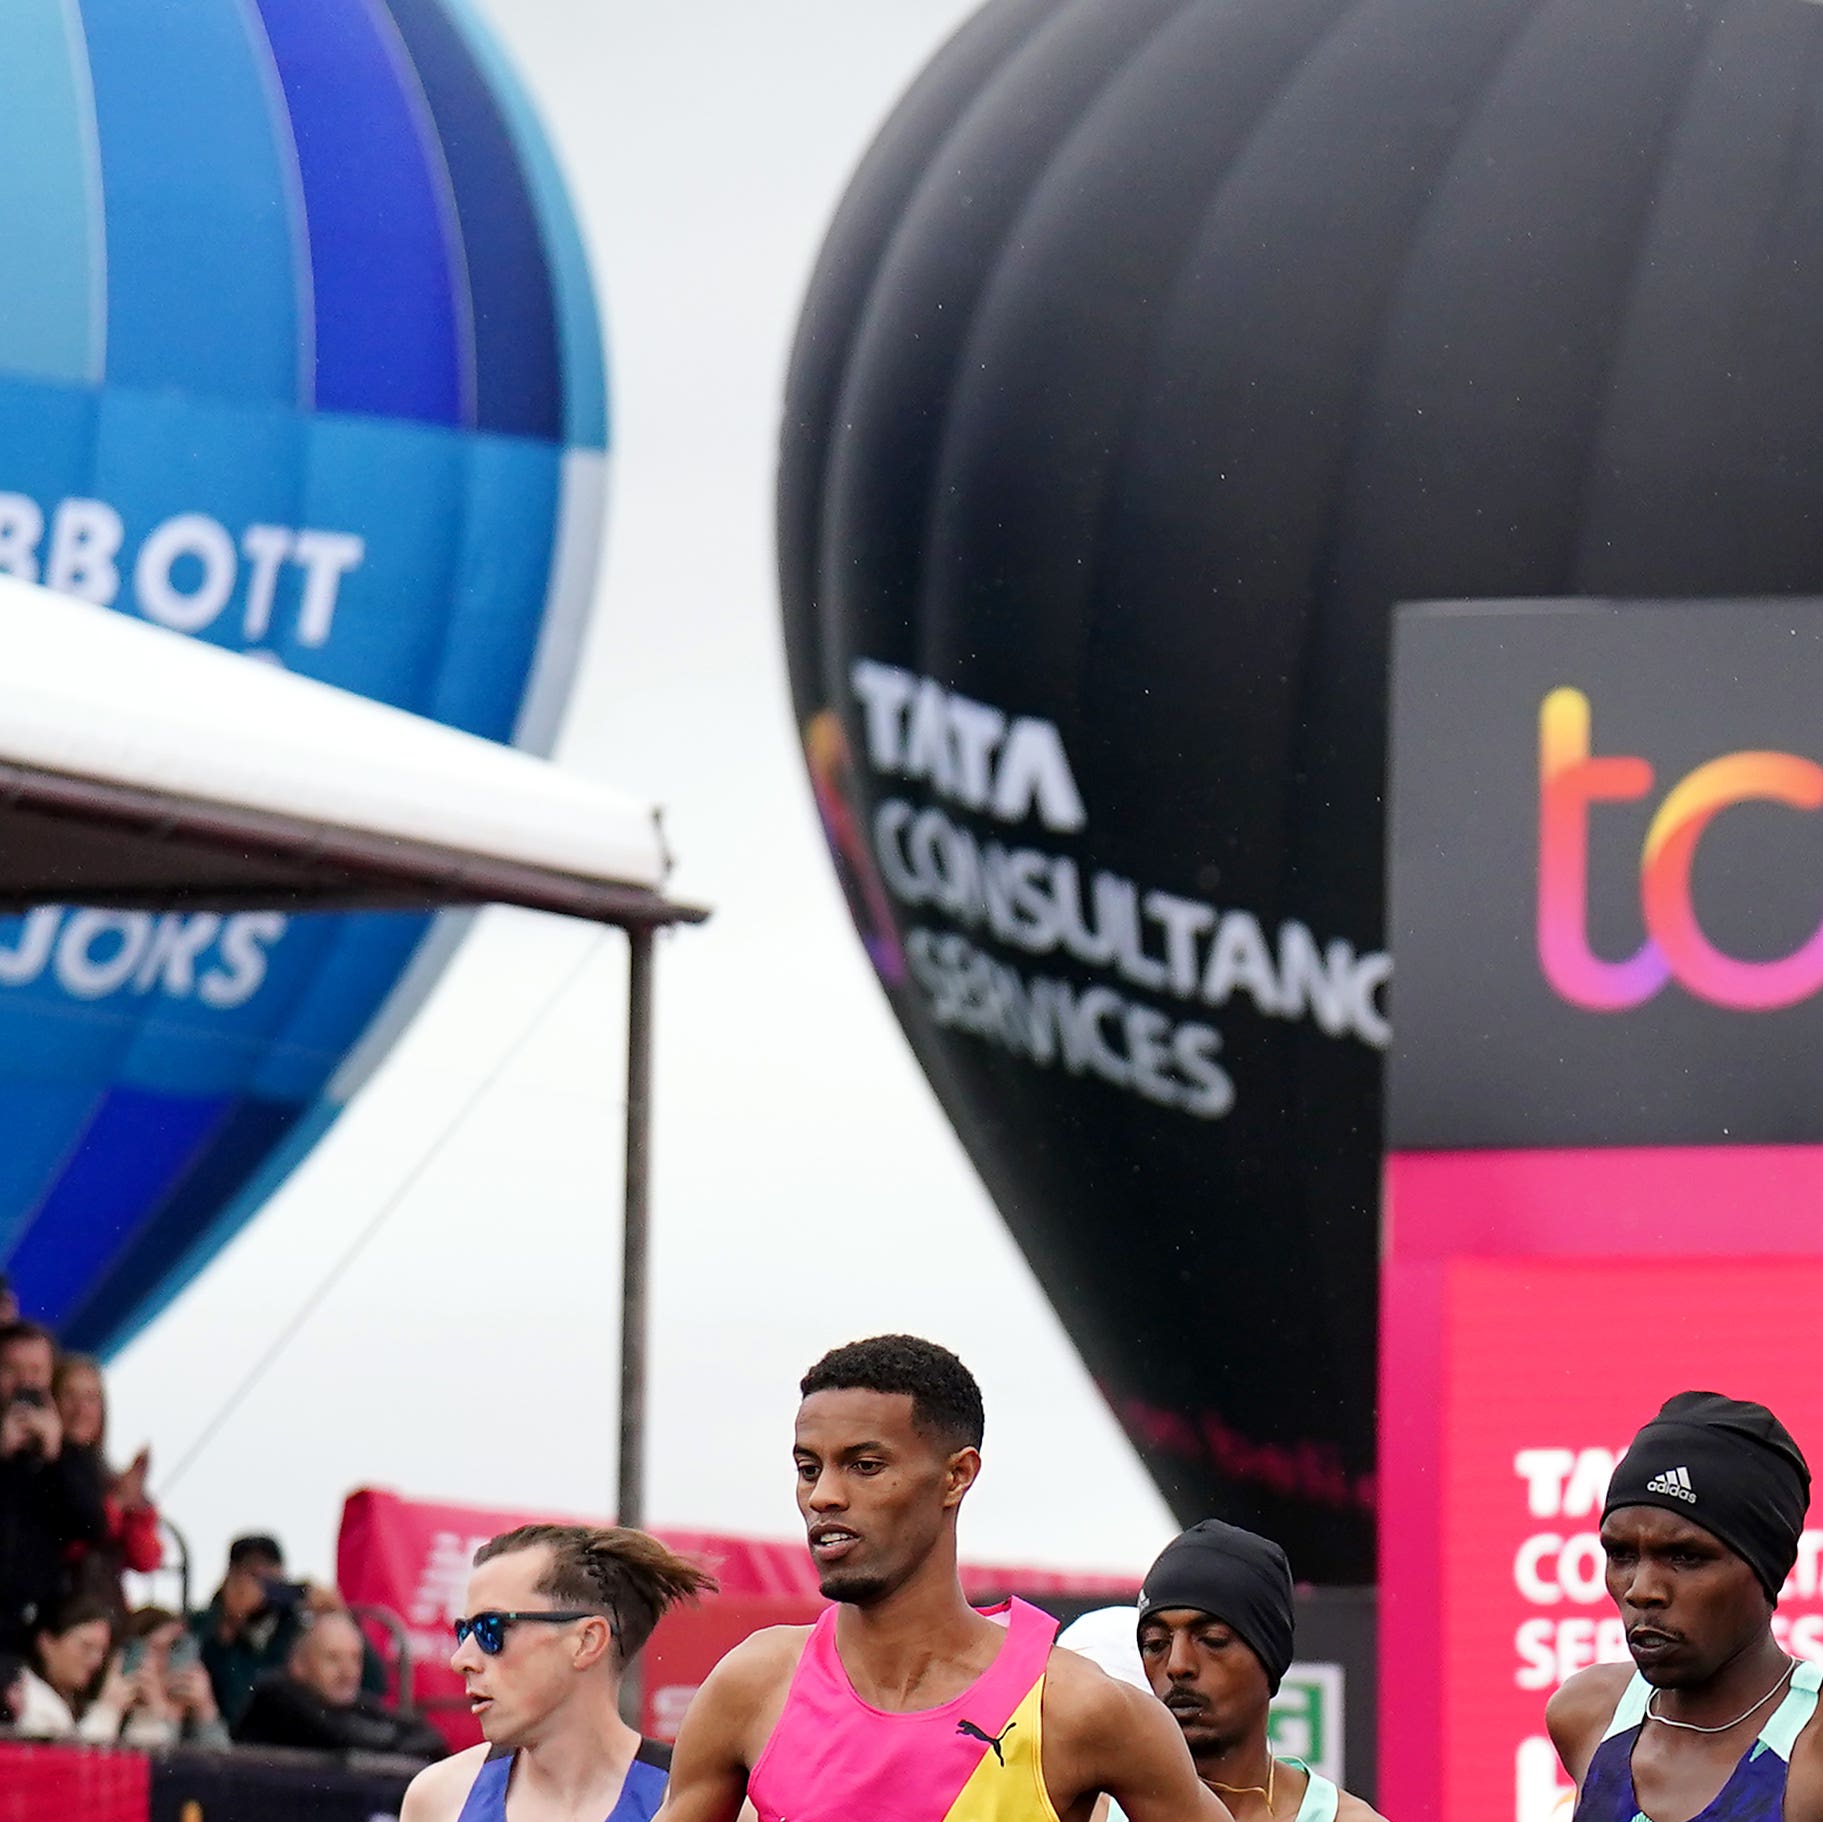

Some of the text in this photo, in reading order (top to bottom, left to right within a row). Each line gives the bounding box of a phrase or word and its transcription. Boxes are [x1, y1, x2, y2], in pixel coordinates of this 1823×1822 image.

[851, 655, 1086, 834] TATA
[903, 926, 1236, 1118] SERVICES
[1514, 1446, 1630, 1518] TA
[1647, 1478, 1697, 1504] adidas
